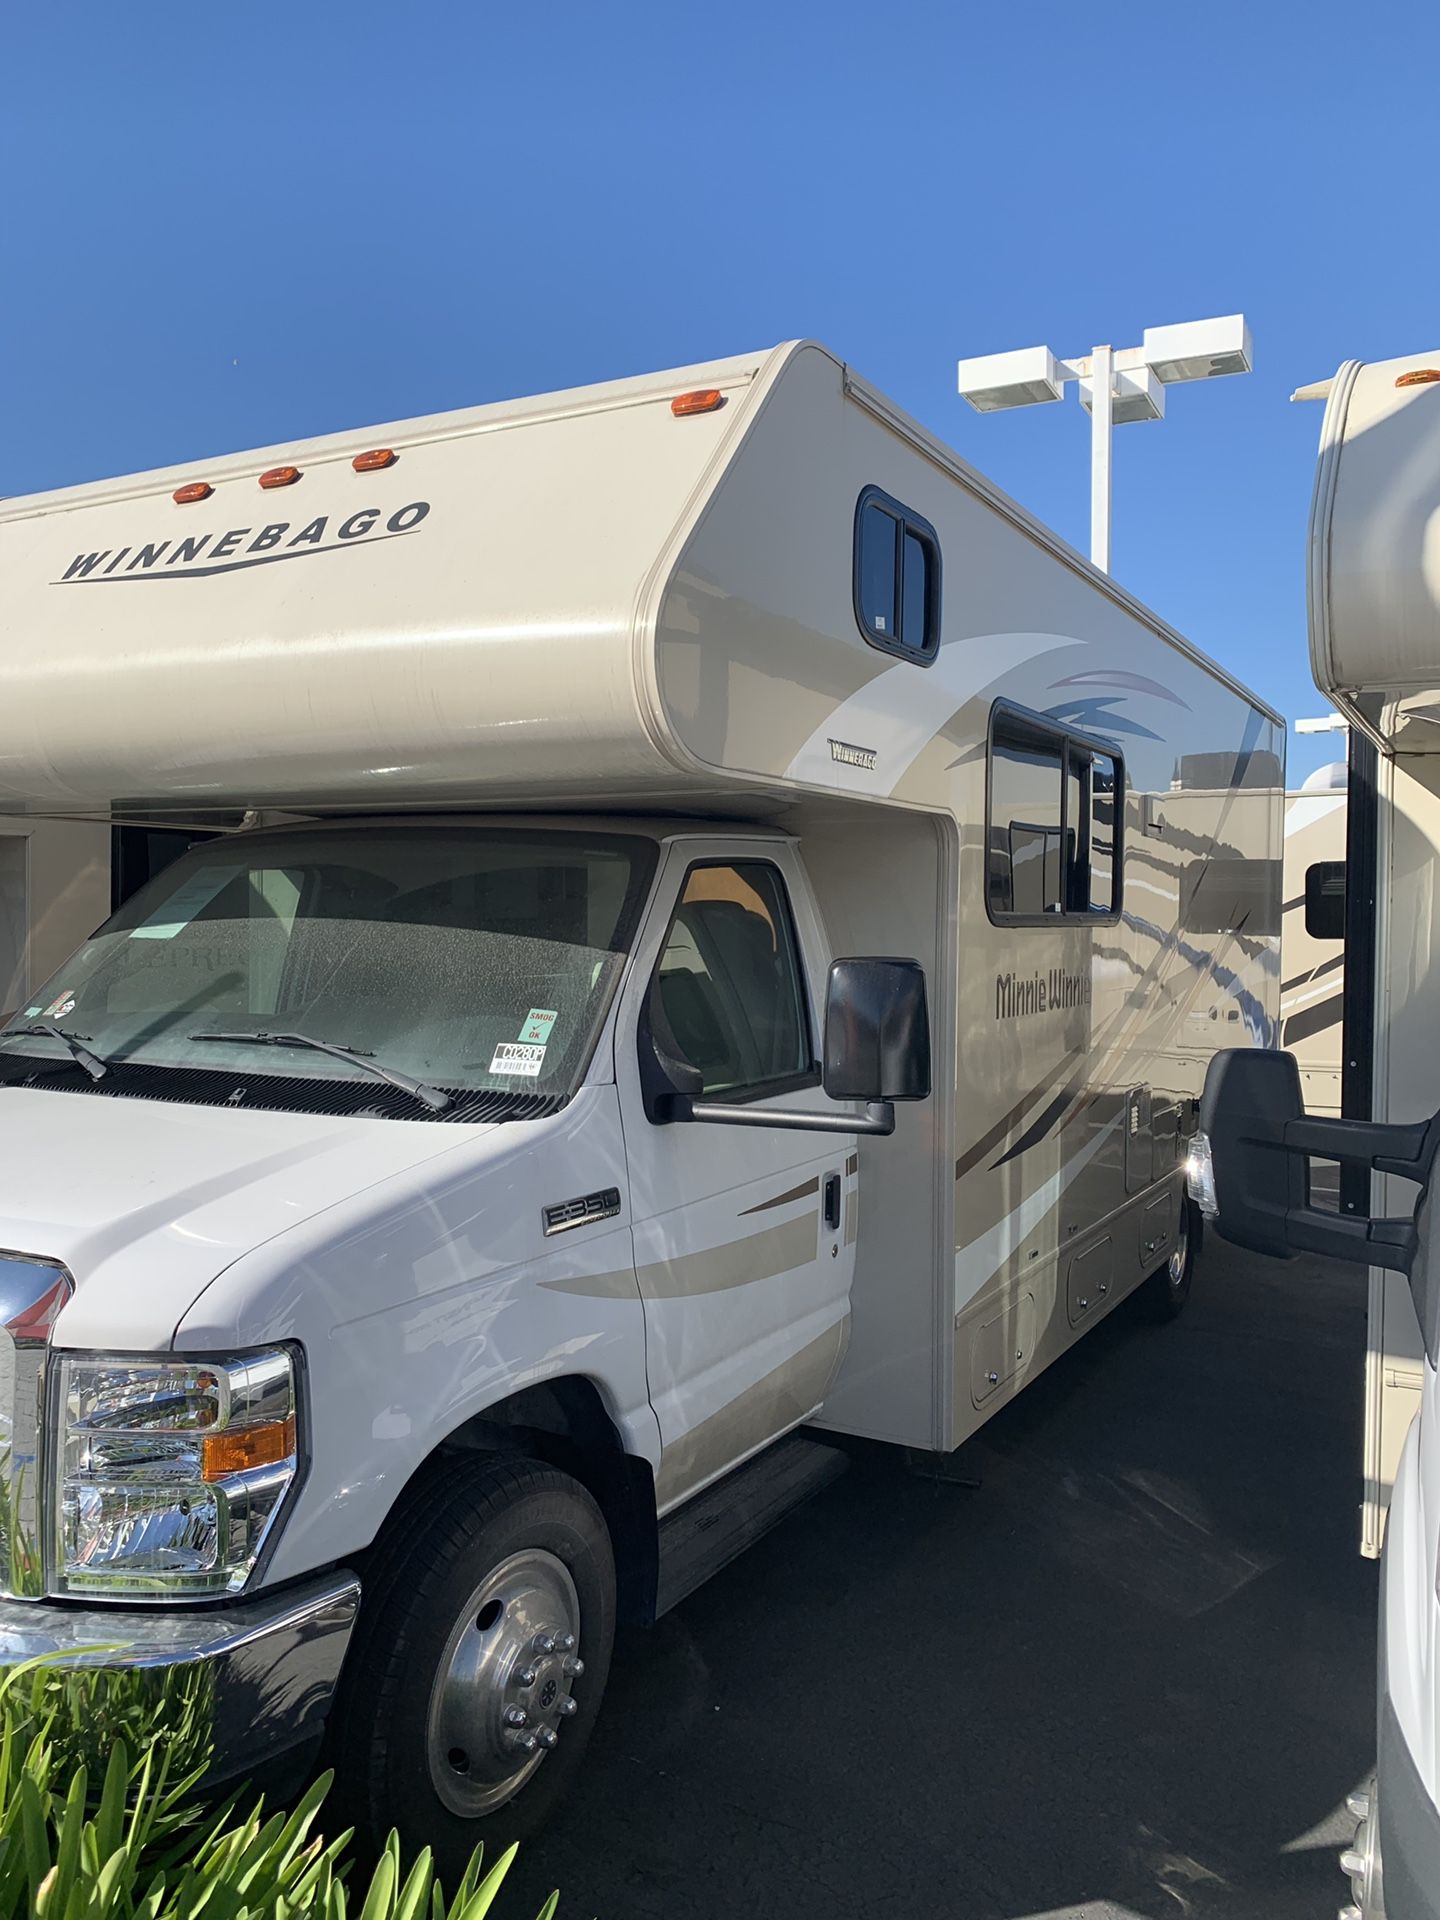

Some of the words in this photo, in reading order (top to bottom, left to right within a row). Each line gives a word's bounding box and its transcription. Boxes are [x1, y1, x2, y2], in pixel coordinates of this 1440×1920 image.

[62, 502, 431, 579] WINNEBAGO
[830, 740, 877, 770] WINNEBAGO
[996, 971, 1046, 1019] Minnie
[530, 1012, 554, 1021] SMOG
